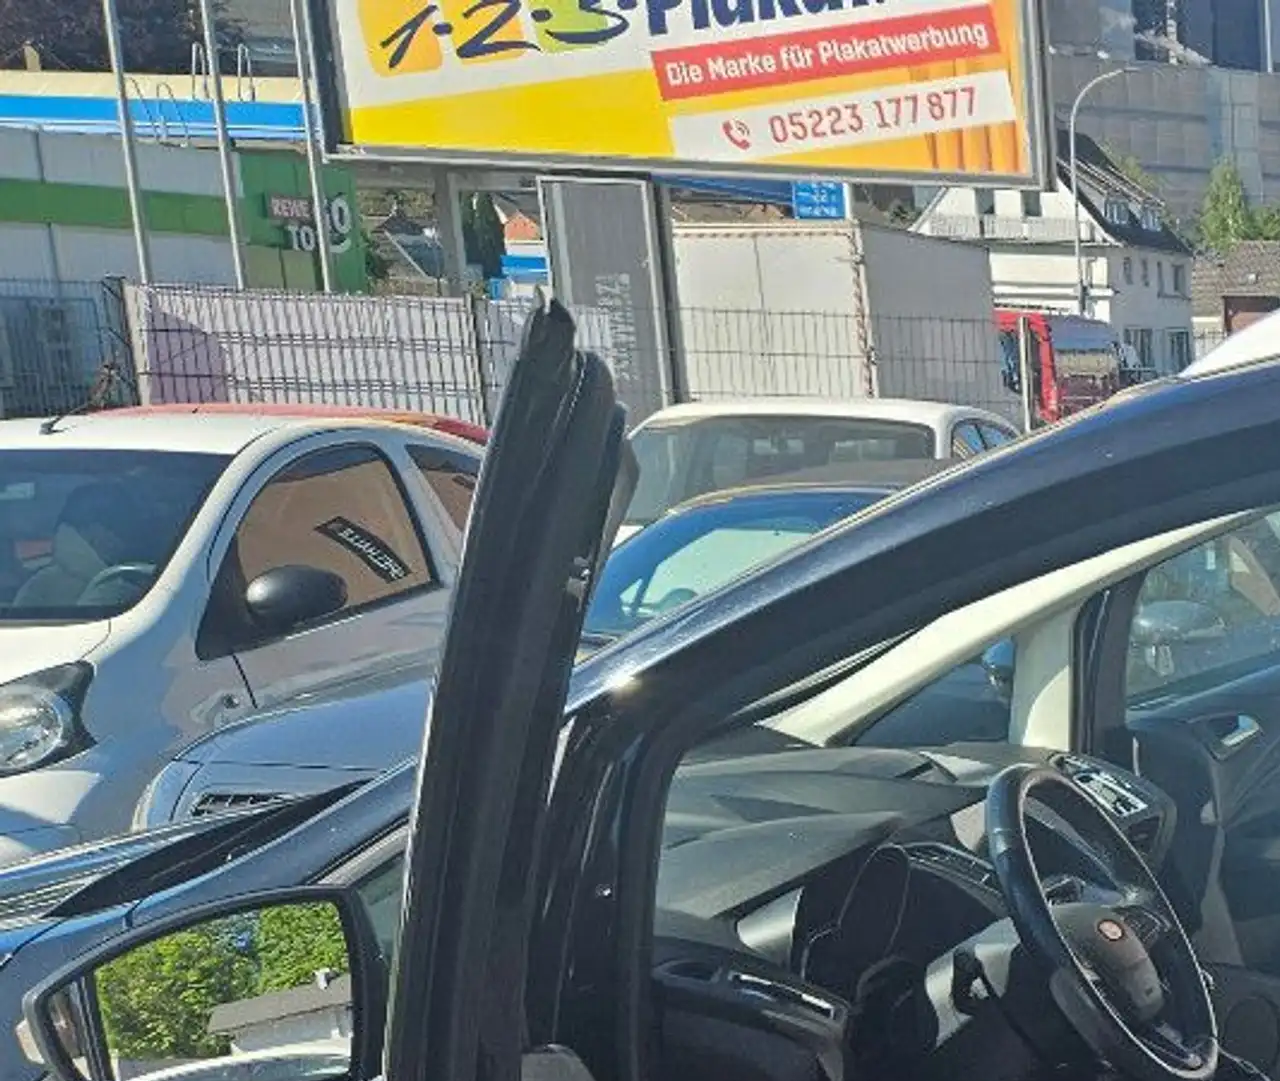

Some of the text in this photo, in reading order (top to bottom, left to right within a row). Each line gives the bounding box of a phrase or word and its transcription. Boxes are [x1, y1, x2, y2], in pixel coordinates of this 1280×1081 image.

[665, 23, 989, 86] Die Marke für Plakatwerbung
[769, 86, 976, 143] 05223 177 877
[270, 197, 311, 218] REWE
